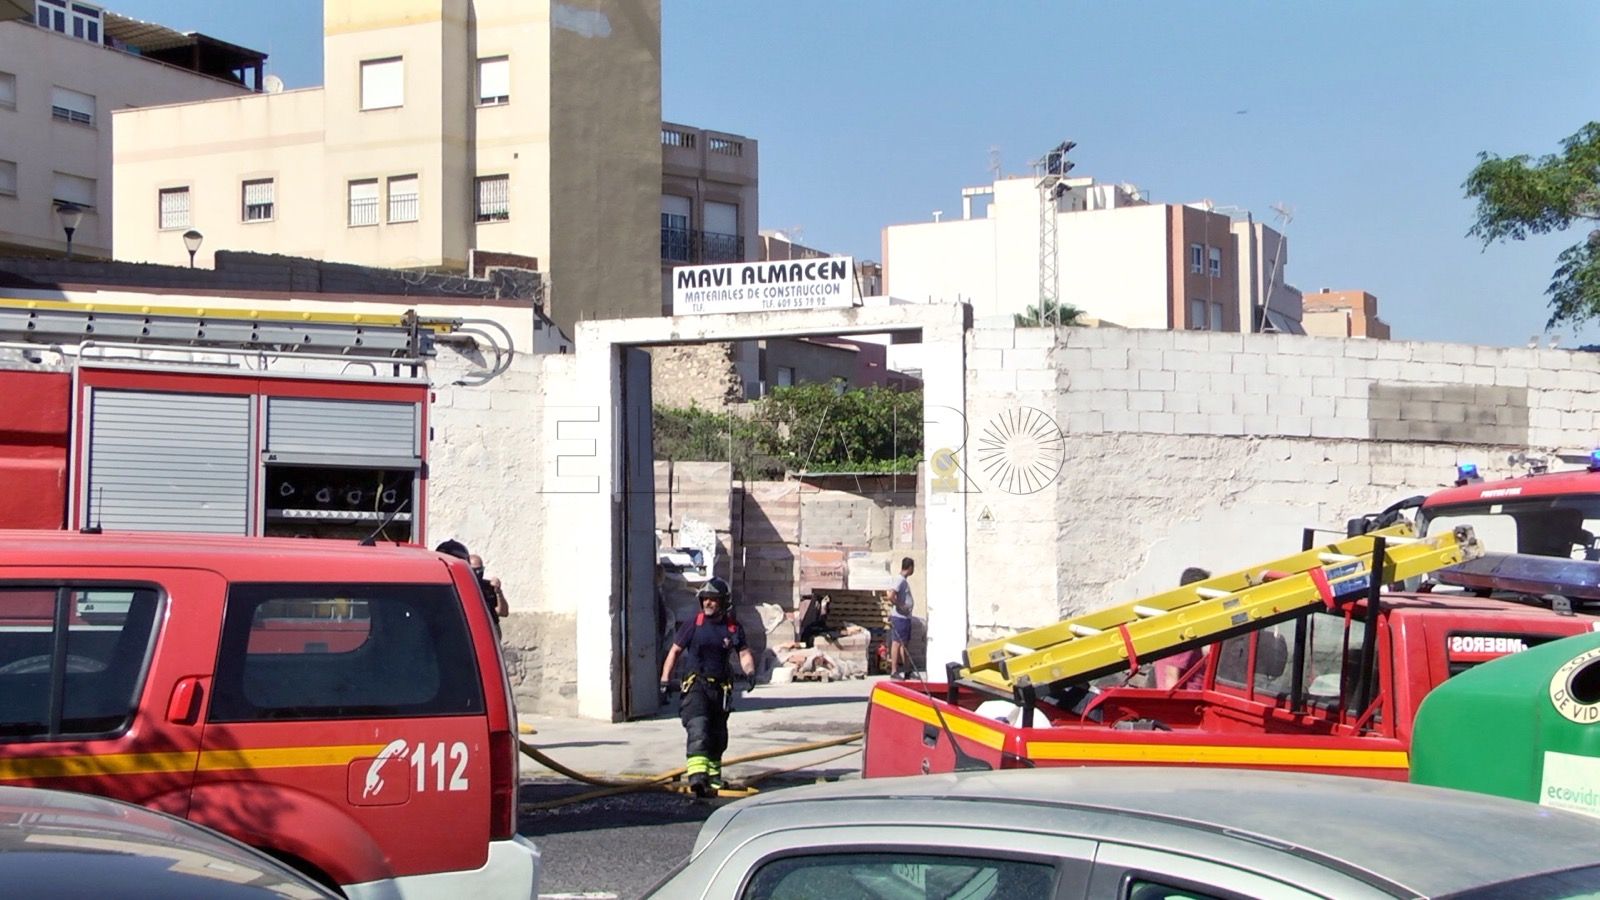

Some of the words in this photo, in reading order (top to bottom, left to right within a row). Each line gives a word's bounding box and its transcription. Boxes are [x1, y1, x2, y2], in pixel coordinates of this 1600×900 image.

[677, 267, 732, 289] MAVI
[741, 261, 846, 285] ALMACEN
[685, 288, 744, 305] MATERIALES
[747, 287, 760, 299] DE
[763, 283, 840, 299] CONSTRUCCION
[777, 298, 791, 308] 609
[793, 297, 803, 307] 55
[816, 296, 826, 305] 92
[1554, 689, 1570, 710] DE
[411, 742, 468, 792] 112
